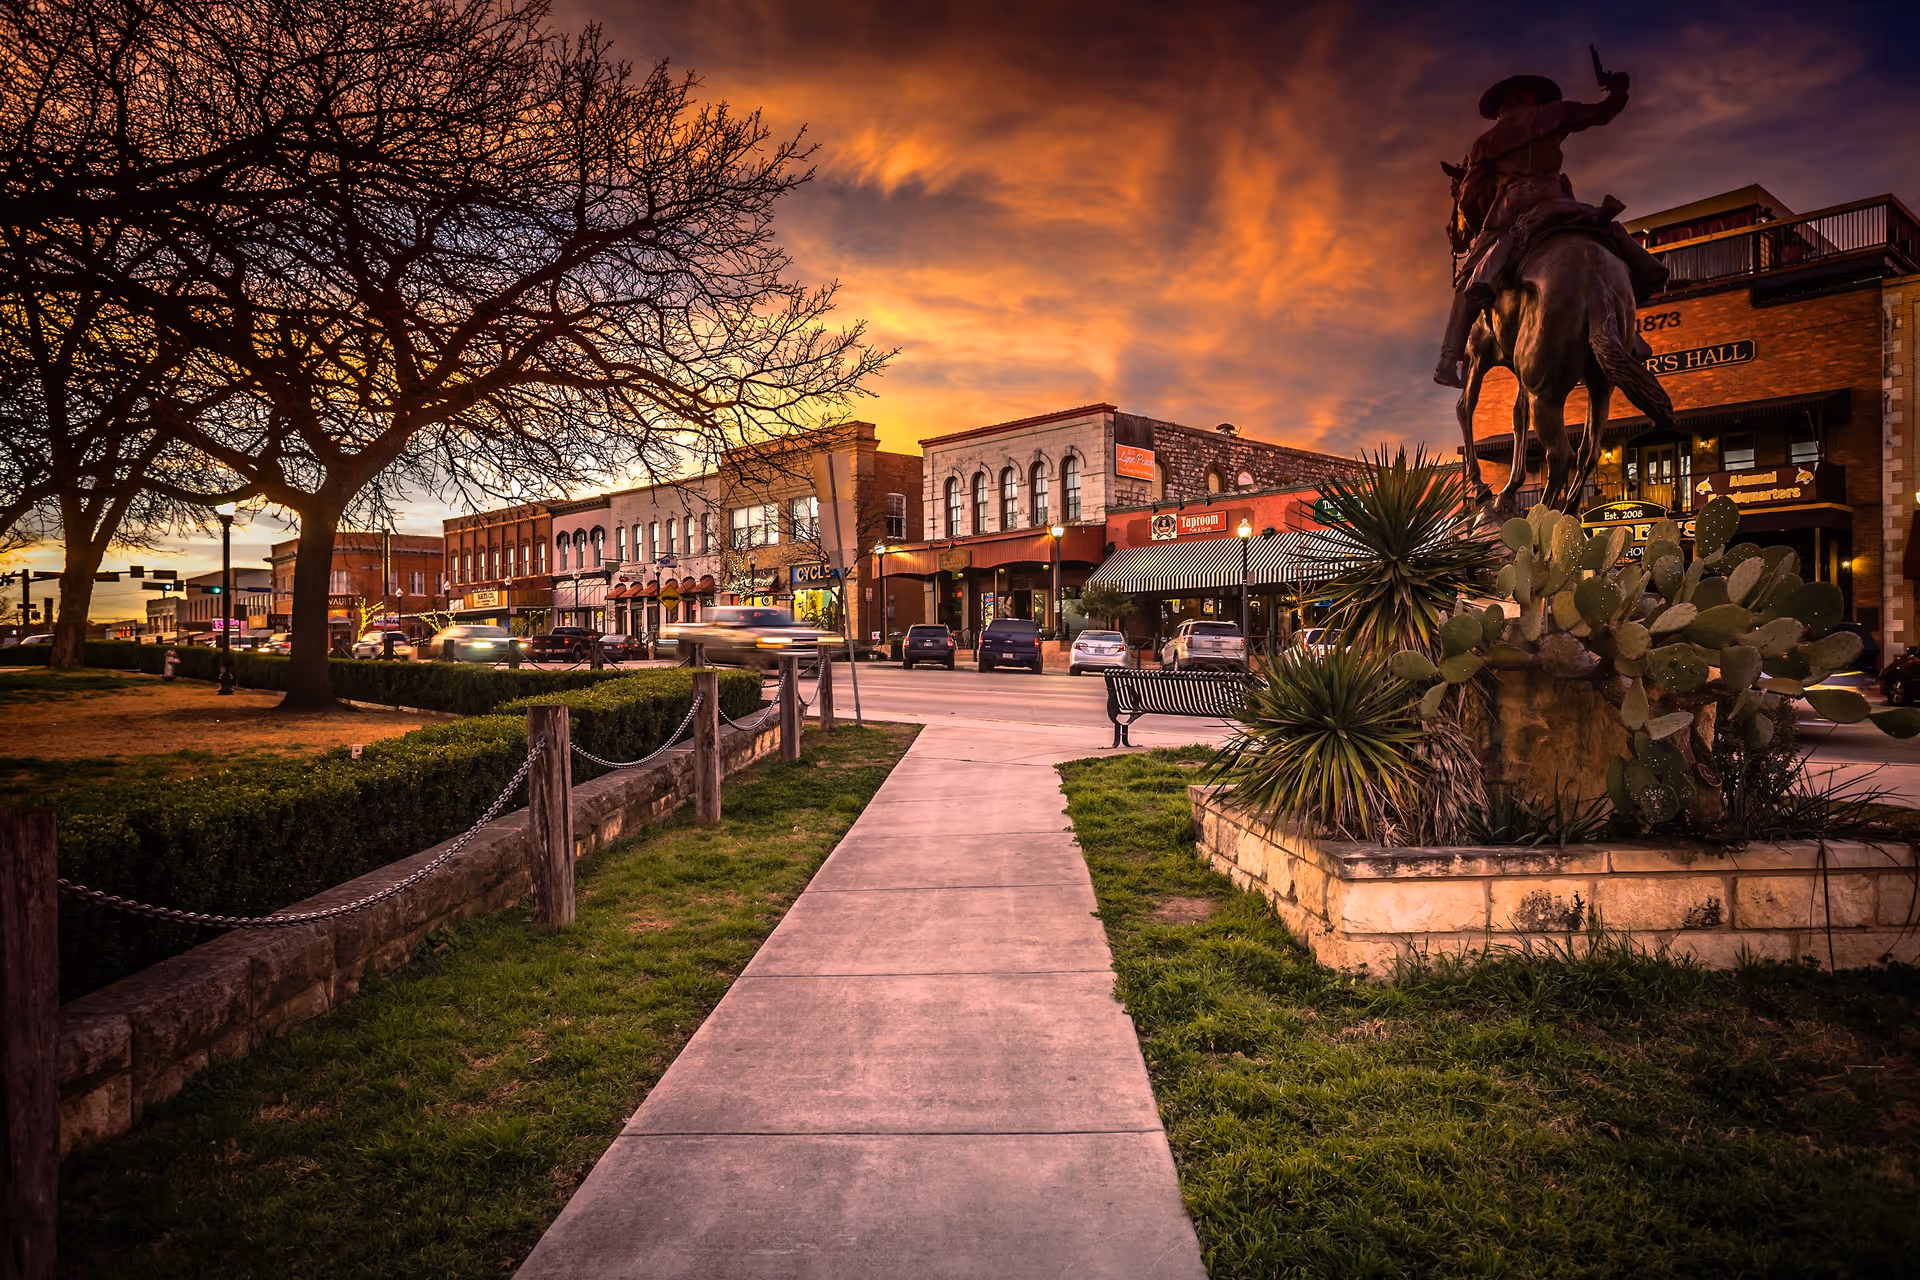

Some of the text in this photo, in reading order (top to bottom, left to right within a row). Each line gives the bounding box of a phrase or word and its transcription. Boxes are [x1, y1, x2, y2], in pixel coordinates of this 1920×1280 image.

[1636, 311, 1681, 332] 1873
[1643, 344, 1747, 373] R'S HALL
[1708, 487, 1801, 504] Hdquarters
[1181, 515, 1219, 529] Taproom
[1603, 509, 1643, 521] Est. 2008
[328, 597, 353, 606] VAULT
